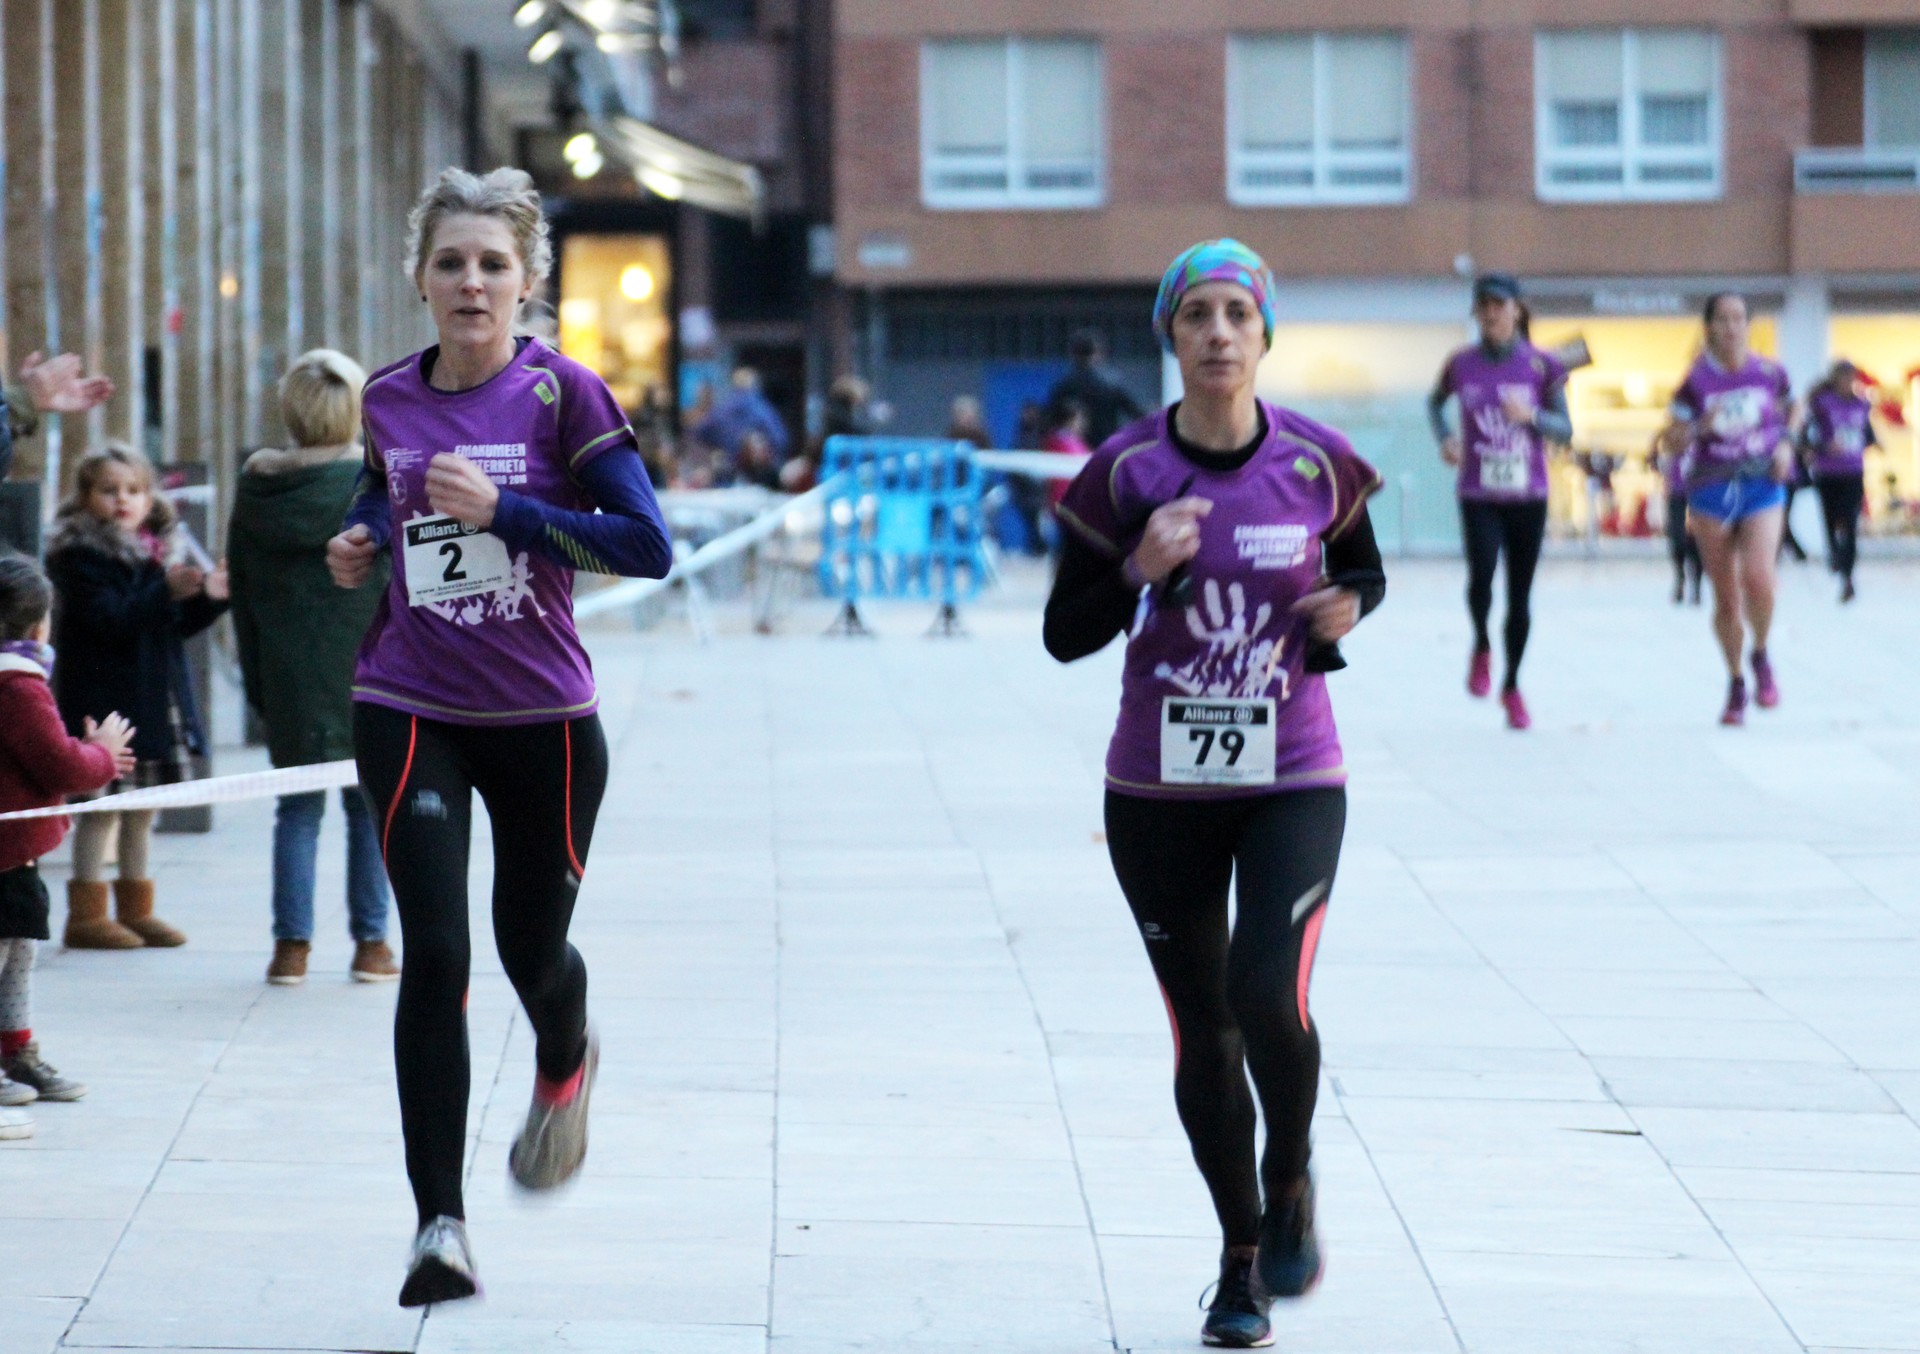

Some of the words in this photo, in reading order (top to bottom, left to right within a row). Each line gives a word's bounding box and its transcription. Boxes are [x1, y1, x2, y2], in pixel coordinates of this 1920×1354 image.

[418, 523, 460, 541] Allianz
[439, 542, 466, 582] 2
[1182, 705, 1231, 723] Allianz
[1189, 728, 1245, 767] 79
